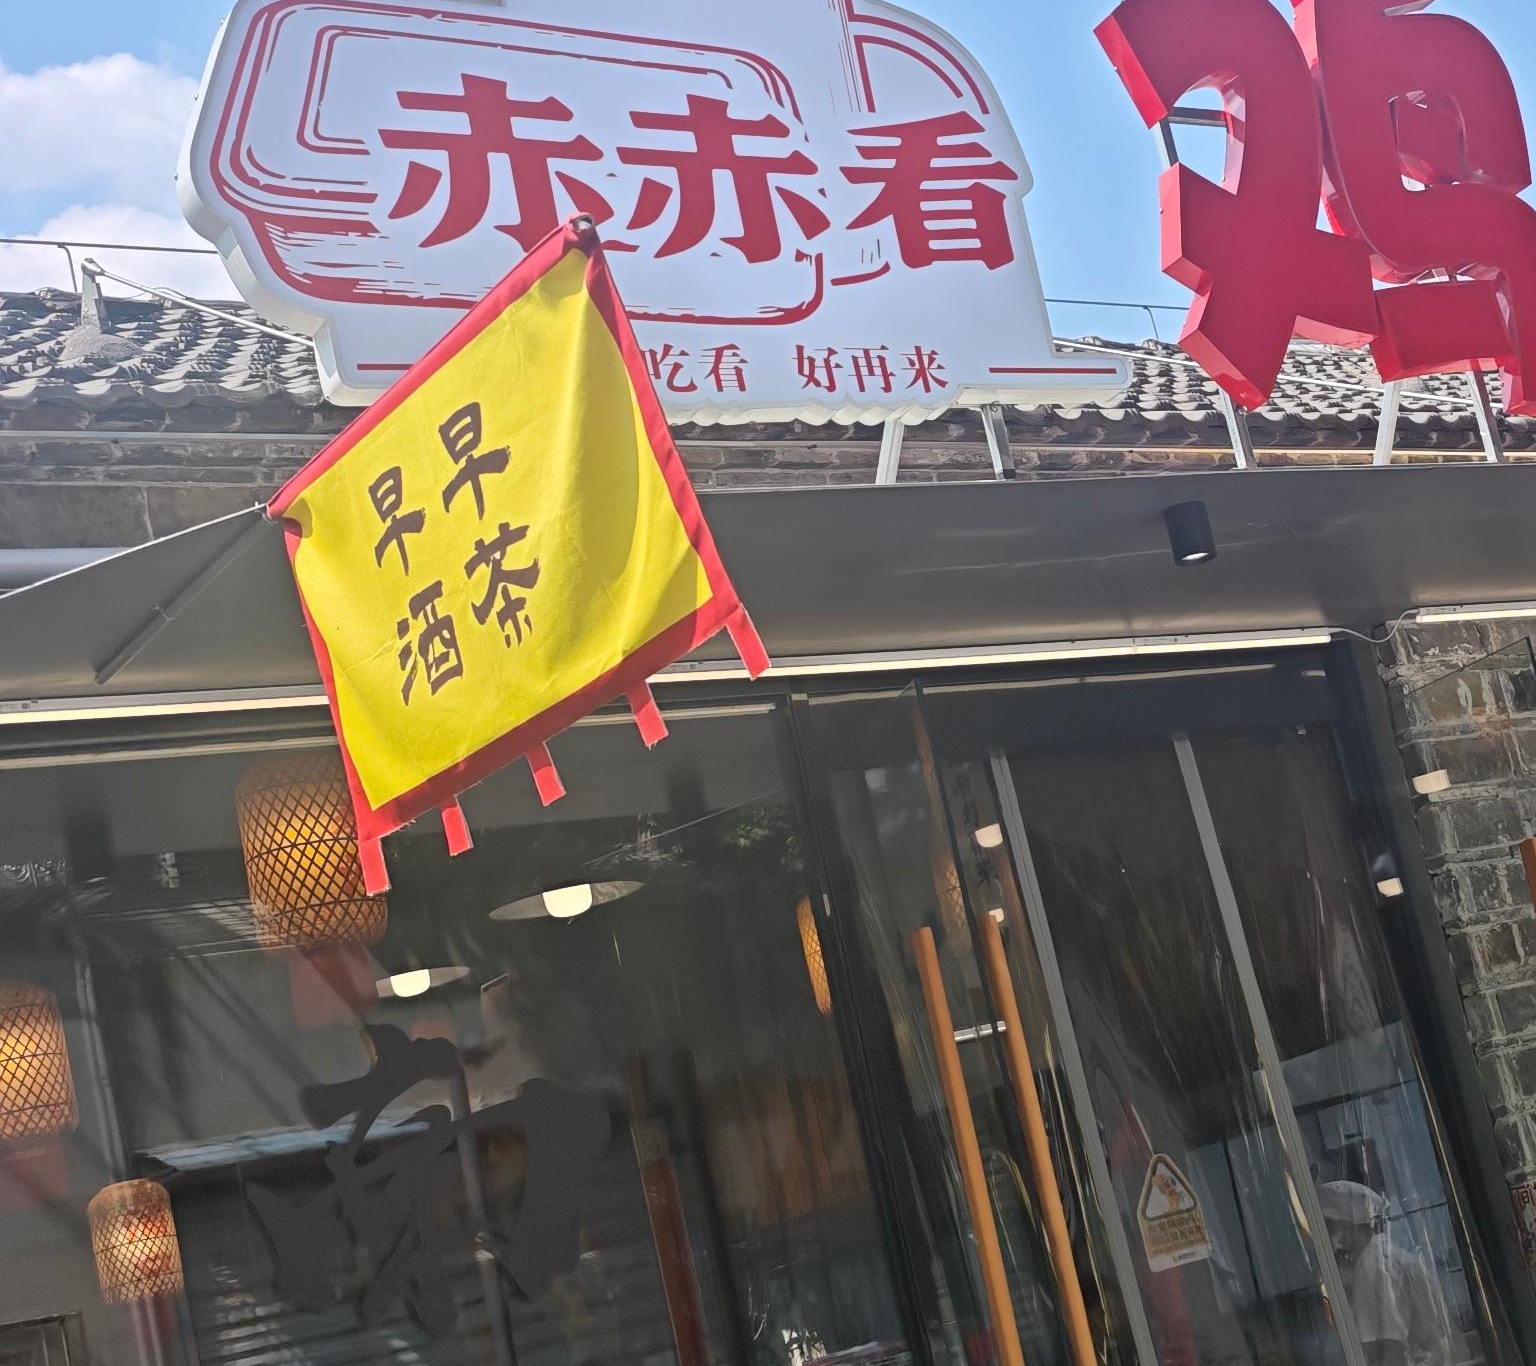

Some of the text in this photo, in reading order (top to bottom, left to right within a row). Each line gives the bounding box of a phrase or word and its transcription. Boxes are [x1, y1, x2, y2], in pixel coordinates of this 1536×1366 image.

[378, 73, 1019, 269] 赤赤看
[792, 344, 950, 394] 好再来
